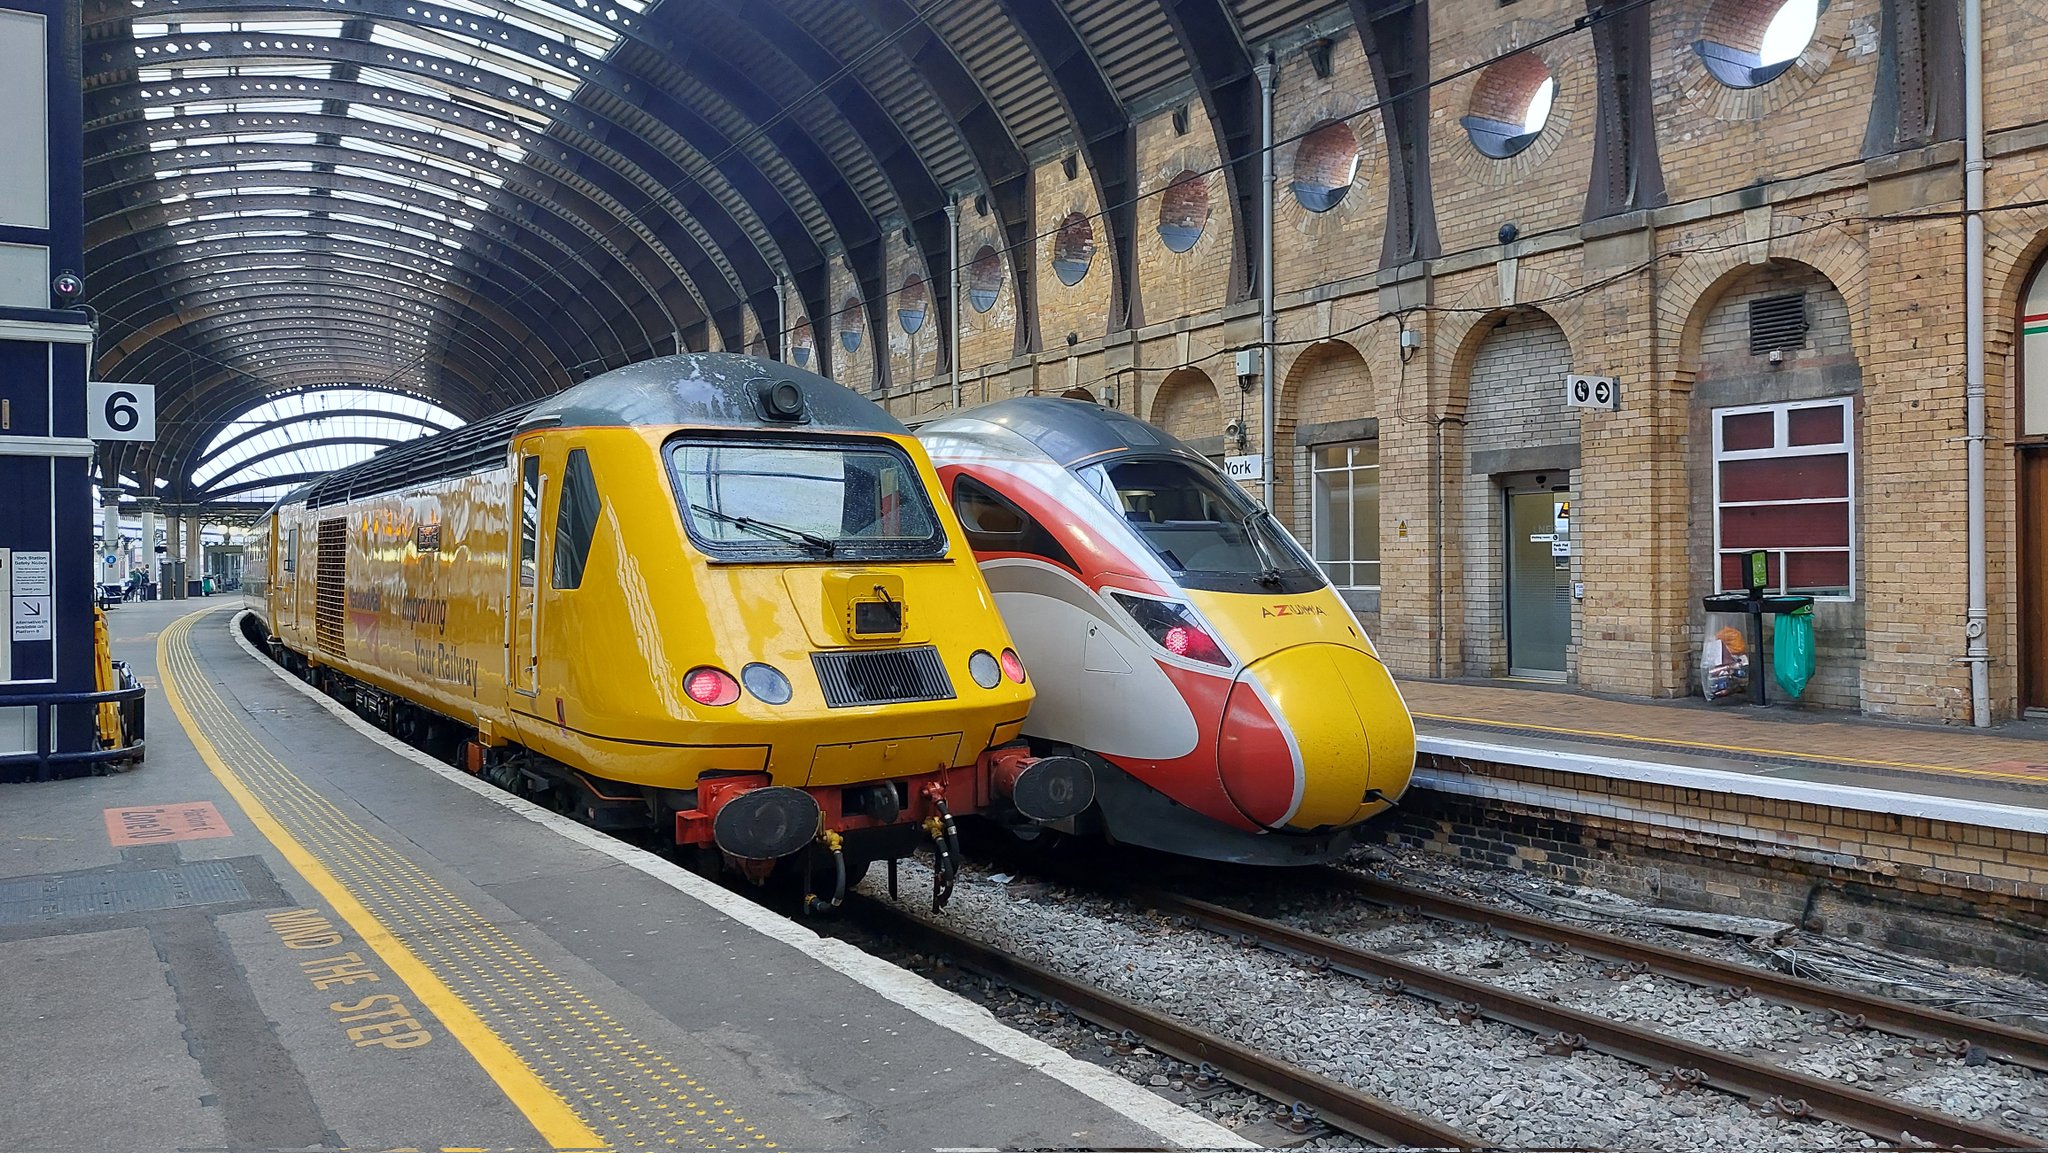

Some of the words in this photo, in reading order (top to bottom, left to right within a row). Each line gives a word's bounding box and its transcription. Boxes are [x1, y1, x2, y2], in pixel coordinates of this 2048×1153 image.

[105, 391, 139, 432] 6
[1225, 460, 1251, 475] York
[401, 597, 447, 635] Improving
[1262, 604, 1328, 618] AZUMA
[414, 638, 437, 676] Your
[436, 643, 479, 698] Railway
[121, 809, 166, 830] Zone
[127, 828, 176, 839] 10
[265, 908, 344, 949] MIND
[300, 951, 381, 991] THE
[330, 994, 432, 1049] STEP
